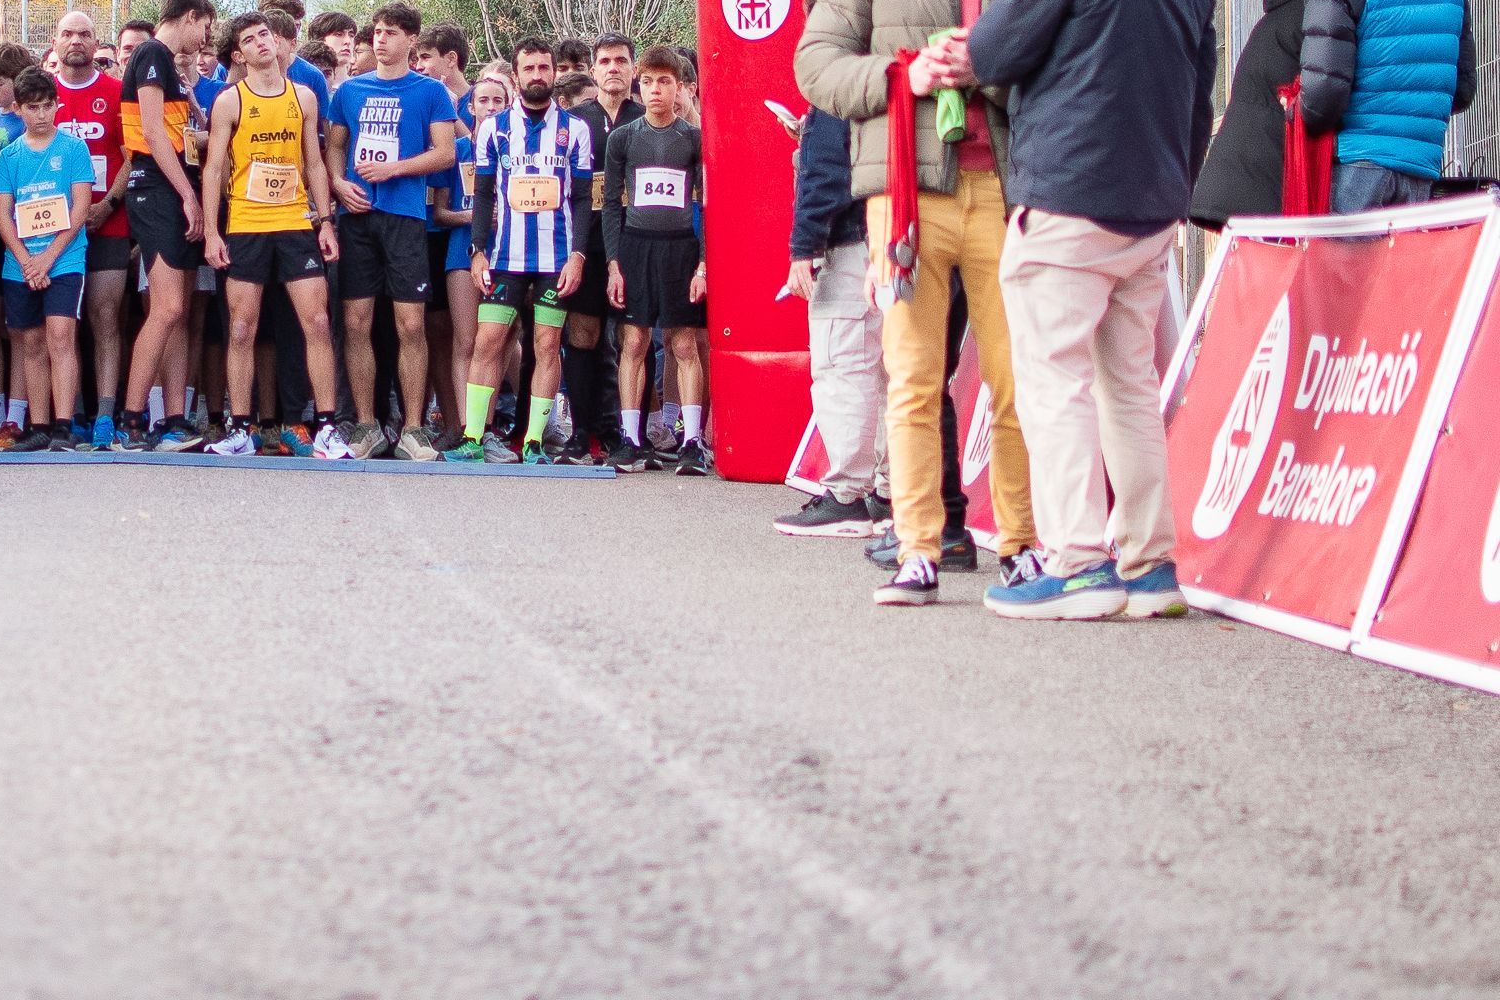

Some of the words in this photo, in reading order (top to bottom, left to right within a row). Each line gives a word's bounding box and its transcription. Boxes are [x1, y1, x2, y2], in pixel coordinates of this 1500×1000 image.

[365, 97, 400, 107] INSTITUT
[359, 107, 402, 122] ARNAU
[360, 148, 387, 162] 810
[265, 178, 286, 189] 107
[644, 182, 675, 196] 842
[531, 187, 536, 197] 1
[34, 210, 51, 220] 40
[32, 220, 57, 230] MARC
[1294, 328, 1422, 431] Diputació
